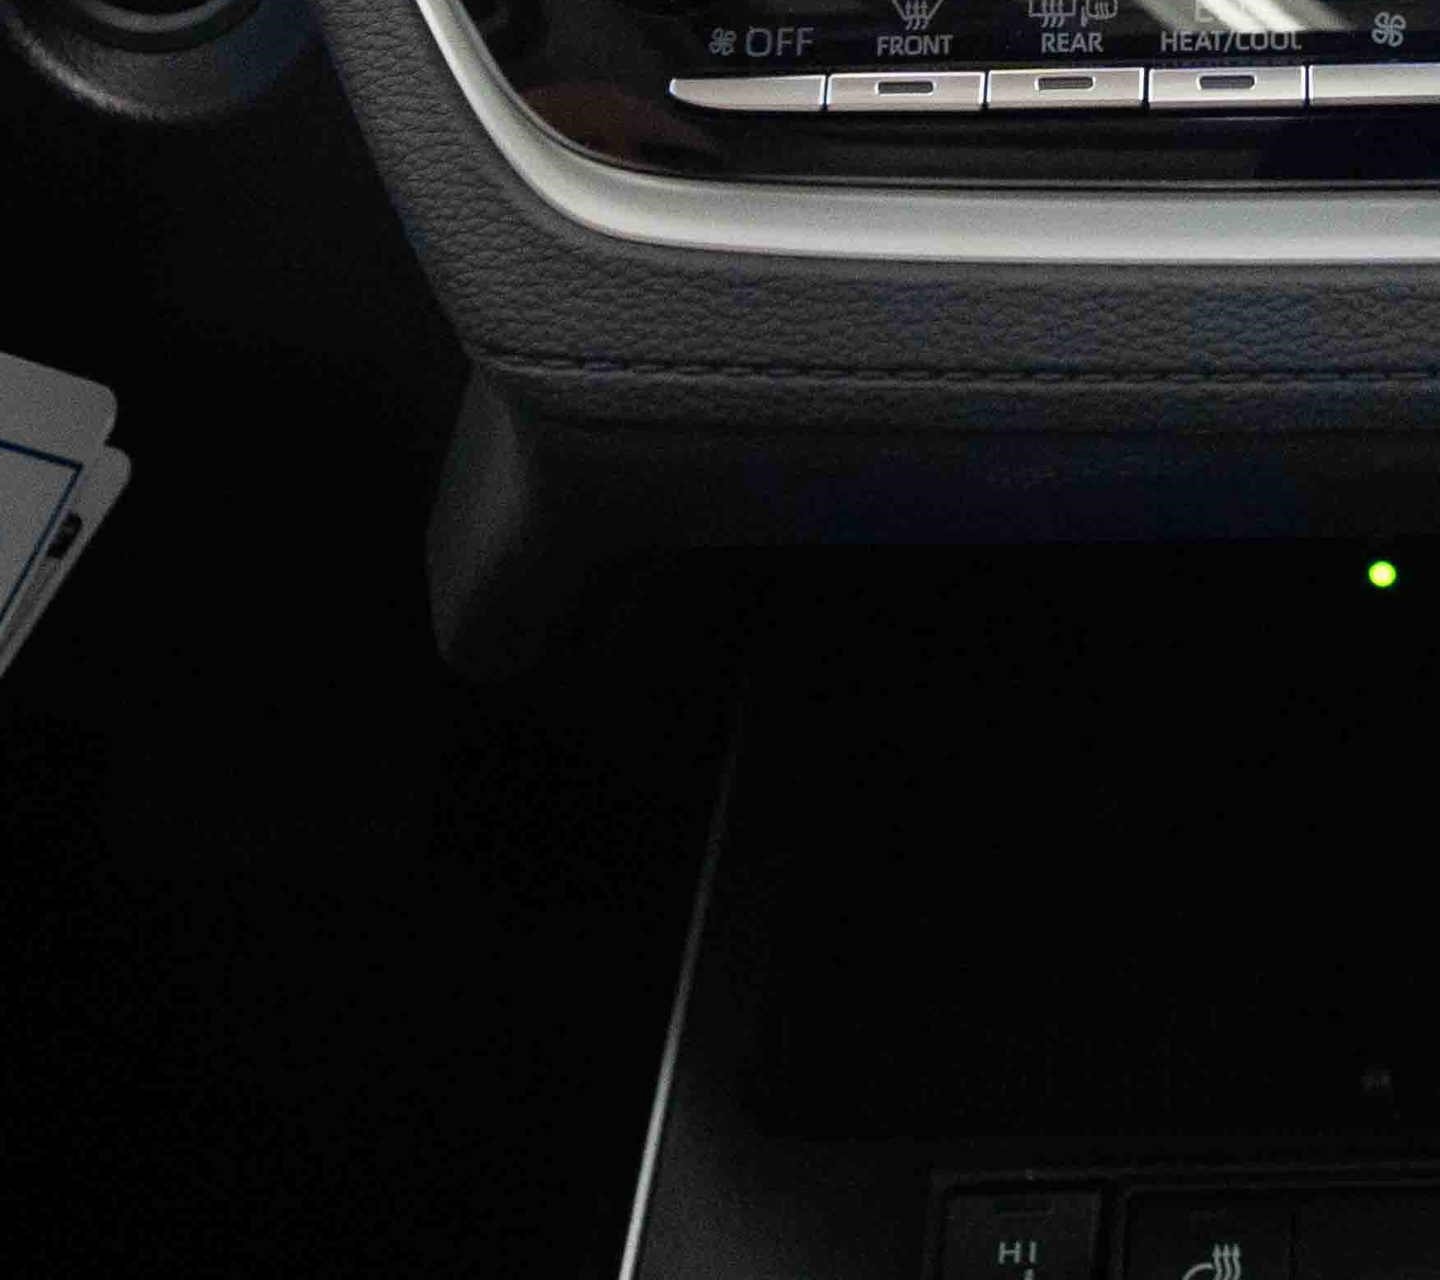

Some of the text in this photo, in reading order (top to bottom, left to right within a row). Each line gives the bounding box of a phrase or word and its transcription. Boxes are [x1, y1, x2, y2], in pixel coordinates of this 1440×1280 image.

[744, 27, 814, 59] OFF
[877, 33, 954, 58] FRONT
[1040, 30, 1105, 56] REAR
[1160, 30, 1303, 52] HEAT/COOL
[997, 1240, 1037, 1264] HI
